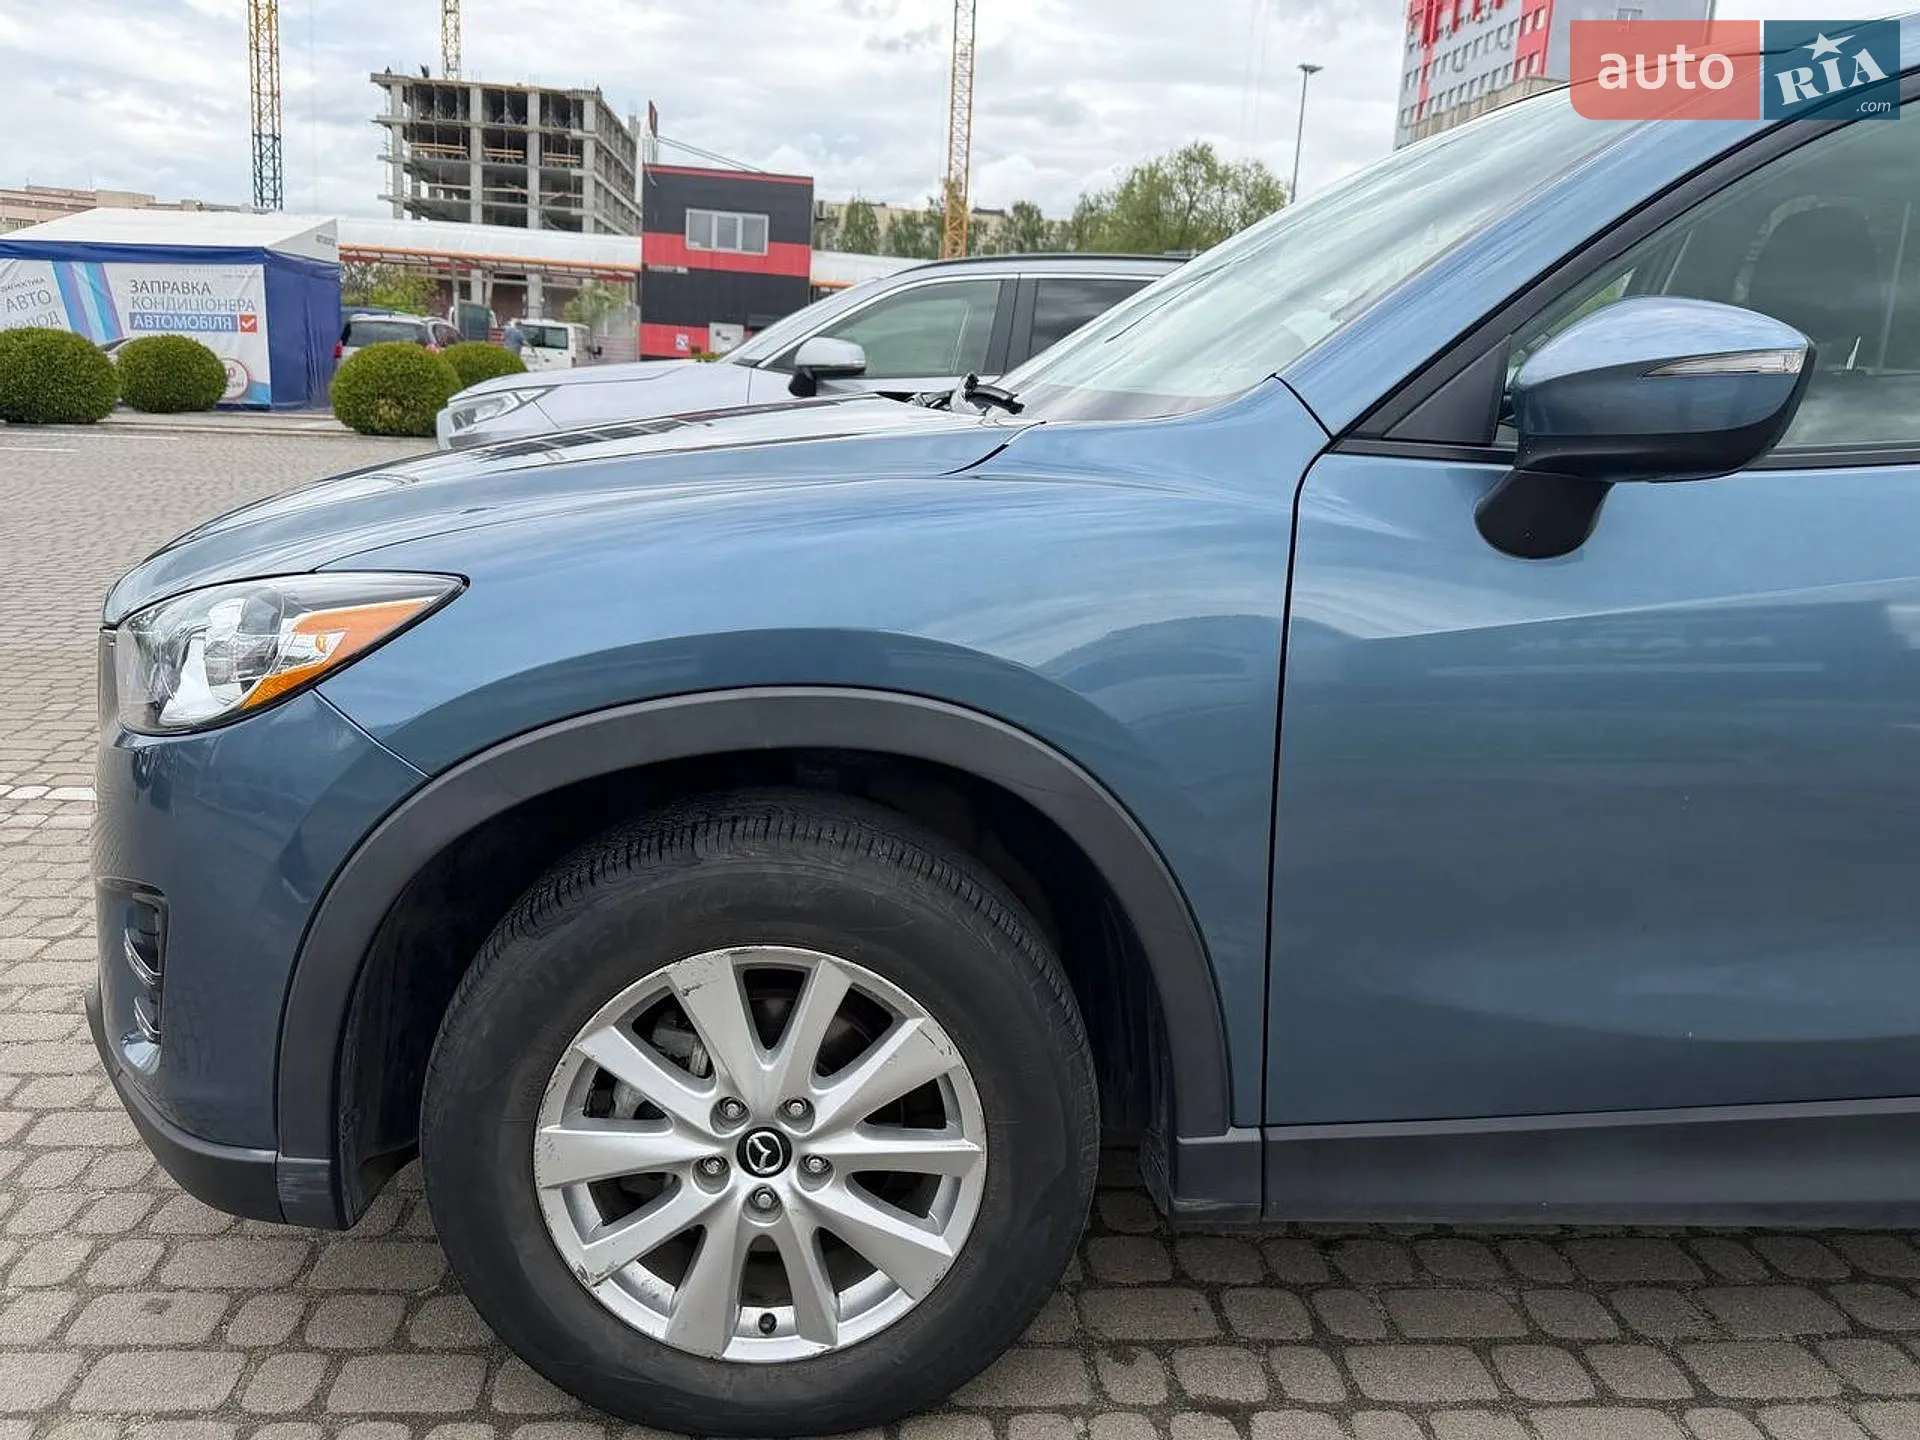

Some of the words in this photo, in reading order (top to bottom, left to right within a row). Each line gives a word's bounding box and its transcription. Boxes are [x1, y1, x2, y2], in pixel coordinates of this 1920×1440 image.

[130, 280, 212, 295] ЗАПРАВКА
[6, 289, 51, 312] АВТО
[131, 296, 256, 312] КОНДИЦІОНЕРА
[132, 314, 232, 330] АВТОМОБІЛЯ
